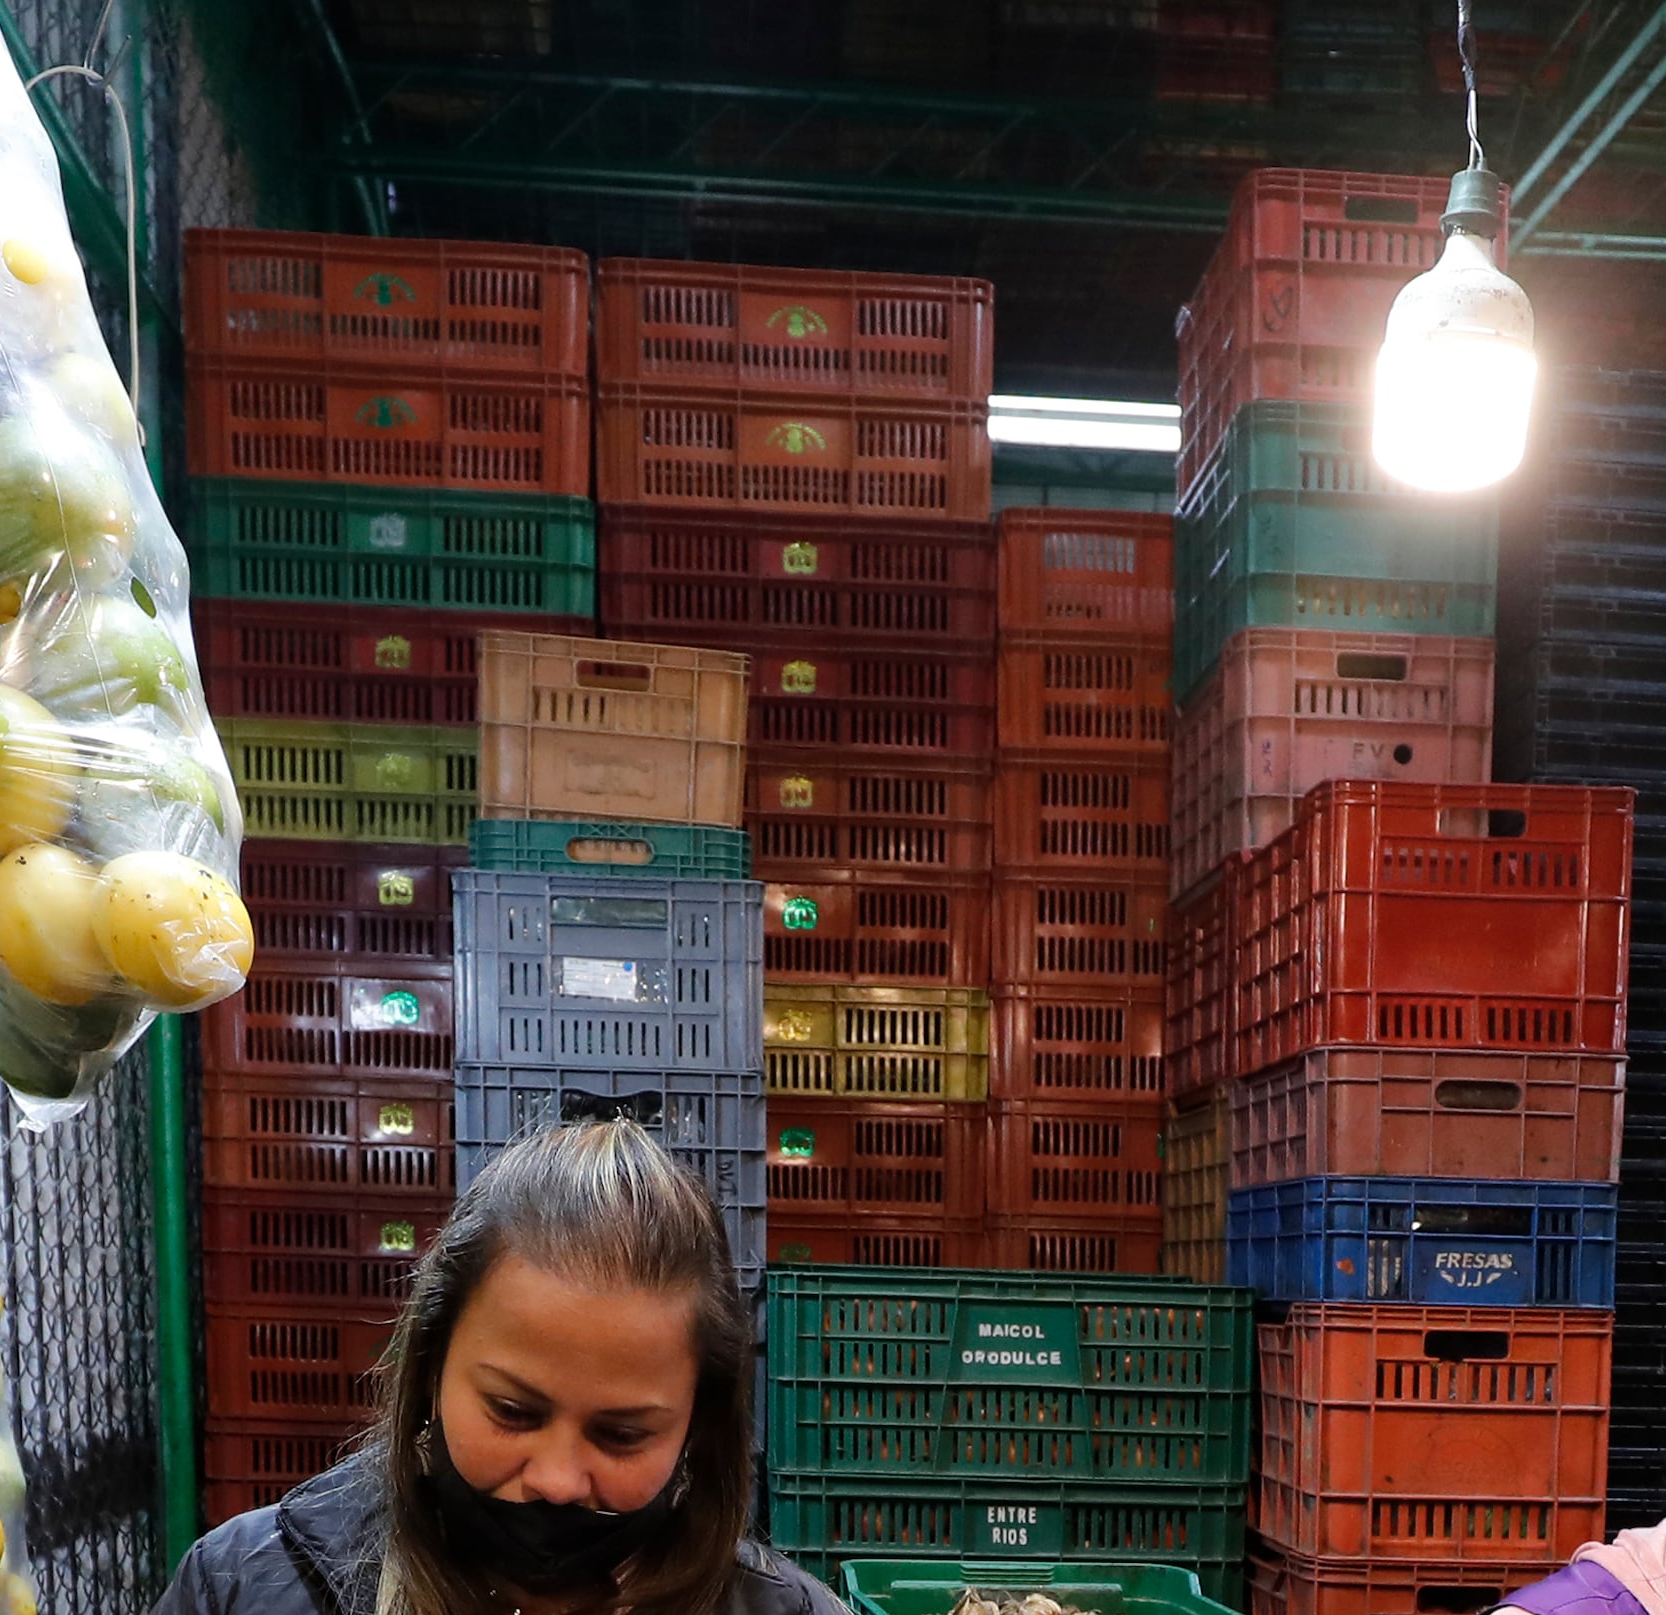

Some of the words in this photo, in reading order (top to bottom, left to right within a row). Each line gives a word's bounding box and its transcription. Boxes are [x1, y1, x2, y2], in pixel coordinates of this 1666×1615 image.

[1435, 1252, 1513, 1269] FRESAS
[978, 1323, 1045, 1339] MAICOL
[961, 1349, 1062, 1365] ORODULCE
[987, 1506, 1037, 1524] ENTRE
[992, 1526, 1028, 1546] RIOS
